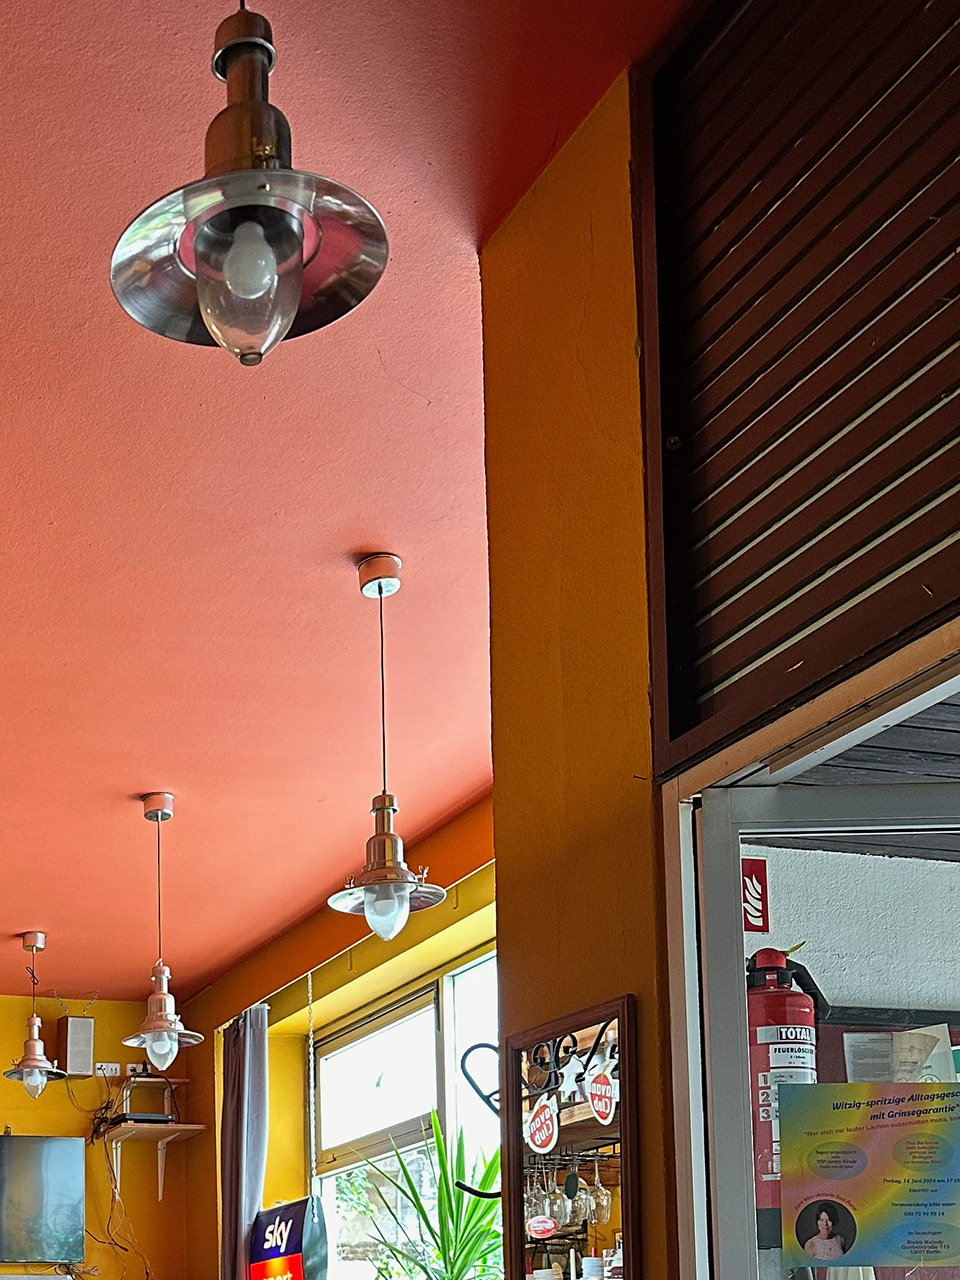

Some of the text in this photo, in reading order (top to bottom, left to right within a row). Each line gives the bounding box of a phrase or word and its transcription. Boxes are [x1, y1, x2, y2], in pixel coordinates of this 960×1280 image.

[780, 1027, 811, 1041] TOTAL
[832, 1096, 906, 1111] Witzig-spritzige
[870, 1111, 886, 1121] mit
[263, 1215, 293, 1254] sky
